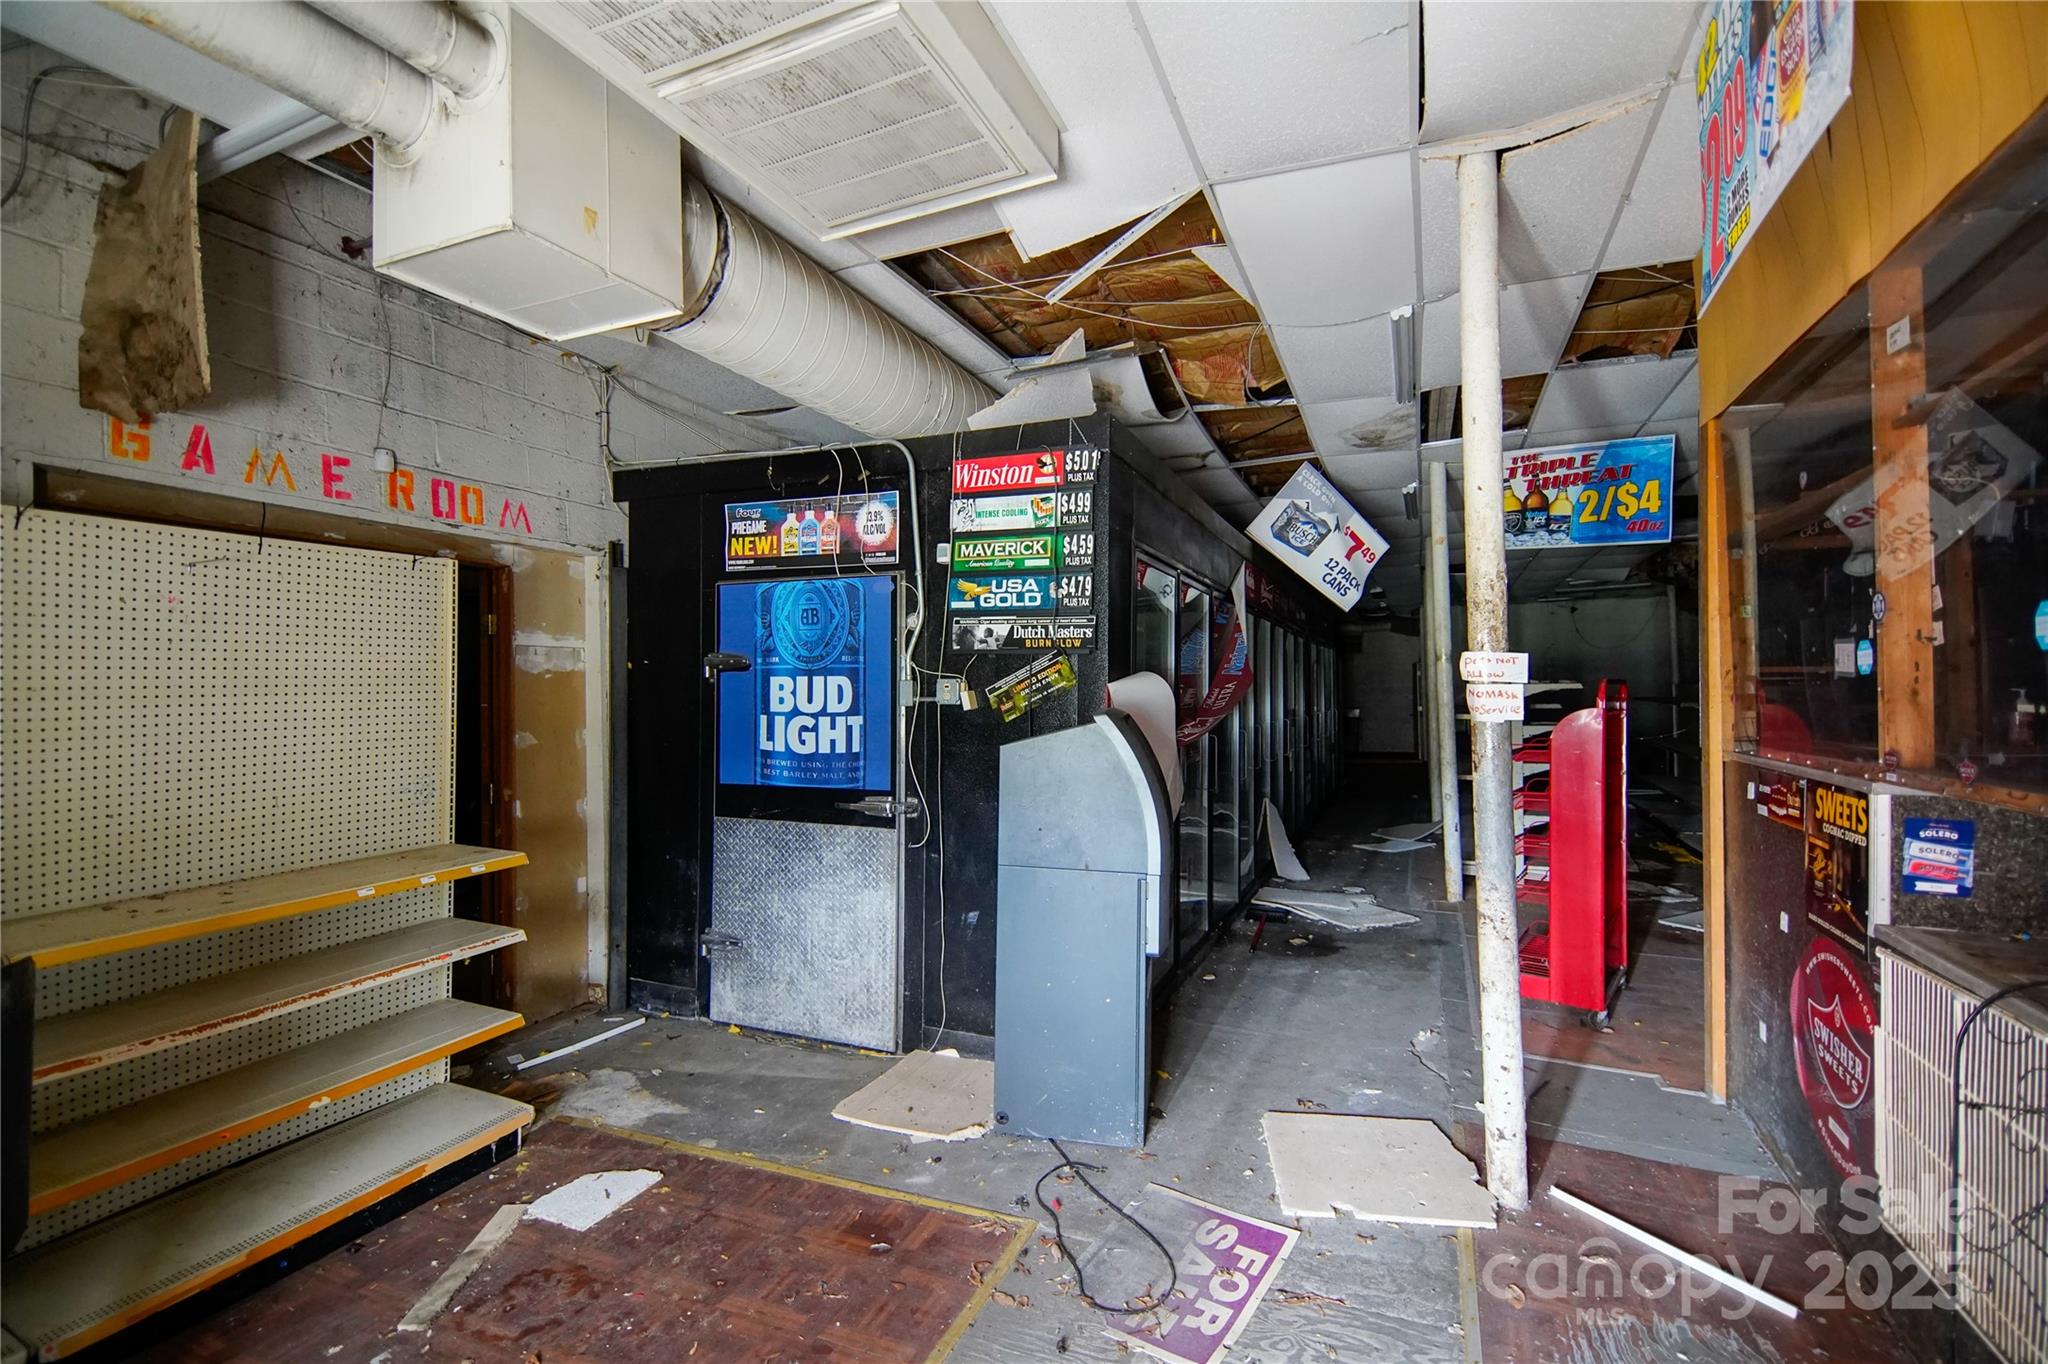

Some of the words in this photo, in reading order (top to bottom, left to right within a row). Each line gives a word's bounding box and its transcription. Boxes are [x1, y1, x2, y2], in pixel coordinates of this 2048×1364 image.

[1505, 452, 1600, 480] TRIPLE
[1511, 452, 1544, 465] THE
[110, 411, 352, 499] GAME
[386, 469, 532, 534] ROOM
[955, 463, 1034, 489] Winston
[1067, 473, 1082, 482] PLUS
[1082, 472, 1095, 481] TAX
[1523, 464, 1638, 492] THREAT
[974, 509, 1000, 519] INTENSE
[1002, 507, 1029, 518] COOLING
[1061, 492, 1091, 514] $4.99
[1578, 479, 1663, 524] 2/$4
[731, 520, 767, 535] PREGAME
[1062, 516, 1077, 525] PLUS
[1077, 515, 1089, 524] TAX
[1288, 521, 1321, 545] BUSCH
[1291, 535, 1306, 545] ICE
[731, 536, 778, 556] NEW!
[960, 540, 1046, 558] MAVERICK
[1063, 534, 1094, 556] $4.59
[1065, 556, 1080, 566] PLUS
[1080, 556, 1092, 565] TAX
[991, 578, 1039, 593] USA
[1061, 575, 1092, 598] $4.79
[1322, 572, 1351, 598] CANS
[1324, 557, 1339, 572] 12
[1337, 566, 1361, 592] PACK
[979, 592, 1043, 608] GOLD
[1063, 598, 1078, 607] PLUS
[1077, 598, 1090, 607] TAX
[1013, 626, 1046, 638] Dutch
[1025, 639, 1052, 648] BURN
[1012, 675, 1037, 693] LIMITD
[1037, 662, 1063, 681] EDITION
[1020, 681, 1041, 697] GREN
[1042, 673, 1059, 686] ENVY
[770, 676, 853, 713] BUD
[1212, 680, 1238, 710] ULTRA
[759, 714, 864, 755] LIGHT
[767, 758, 798, 767] BREWED
[783, 770, 818, 779] BARLEY
[1815, 787, 1868, 835] SWEETS
[1822, 822, 1844, 841] COGNAC
[1844, 829, 1867, 848] DIPPED
[1919, 829, 1959, 840] SOLERO
[1918, 847, 1960, 860] SOLERO
[1813, 1017, 1863, 1083] SWISHER
[1817, 1044, 1859, 1095] SWEETS
[1181, 1244, 1269, 1336] FOR
